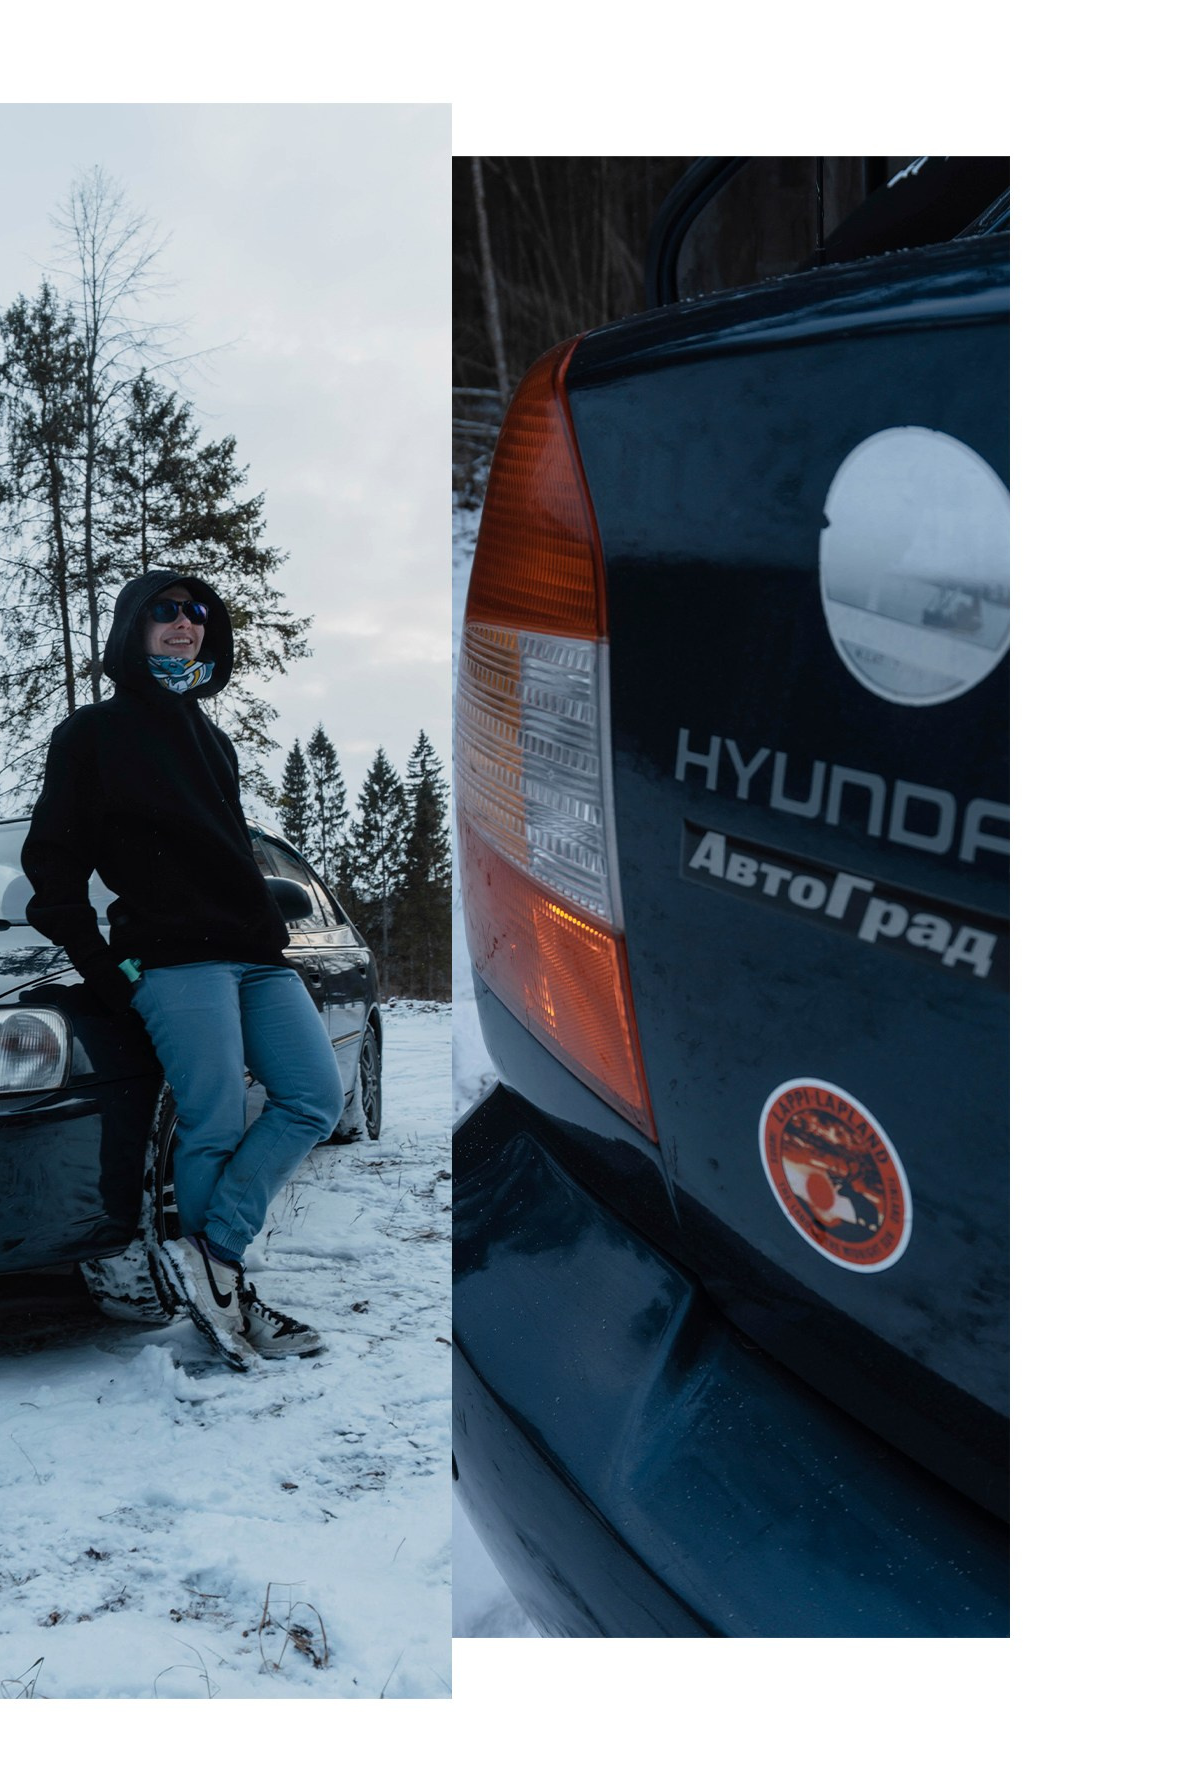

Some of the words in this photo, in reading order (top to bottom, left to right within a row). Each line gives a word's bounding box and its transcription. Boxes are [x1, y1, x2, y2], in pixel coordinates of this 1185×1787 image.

[689, 830, 998, 977] АвтоГрад
[772, 1088, 808, 1124] LAPPI
[815, 1090, 889, 1164] LAPLAND
